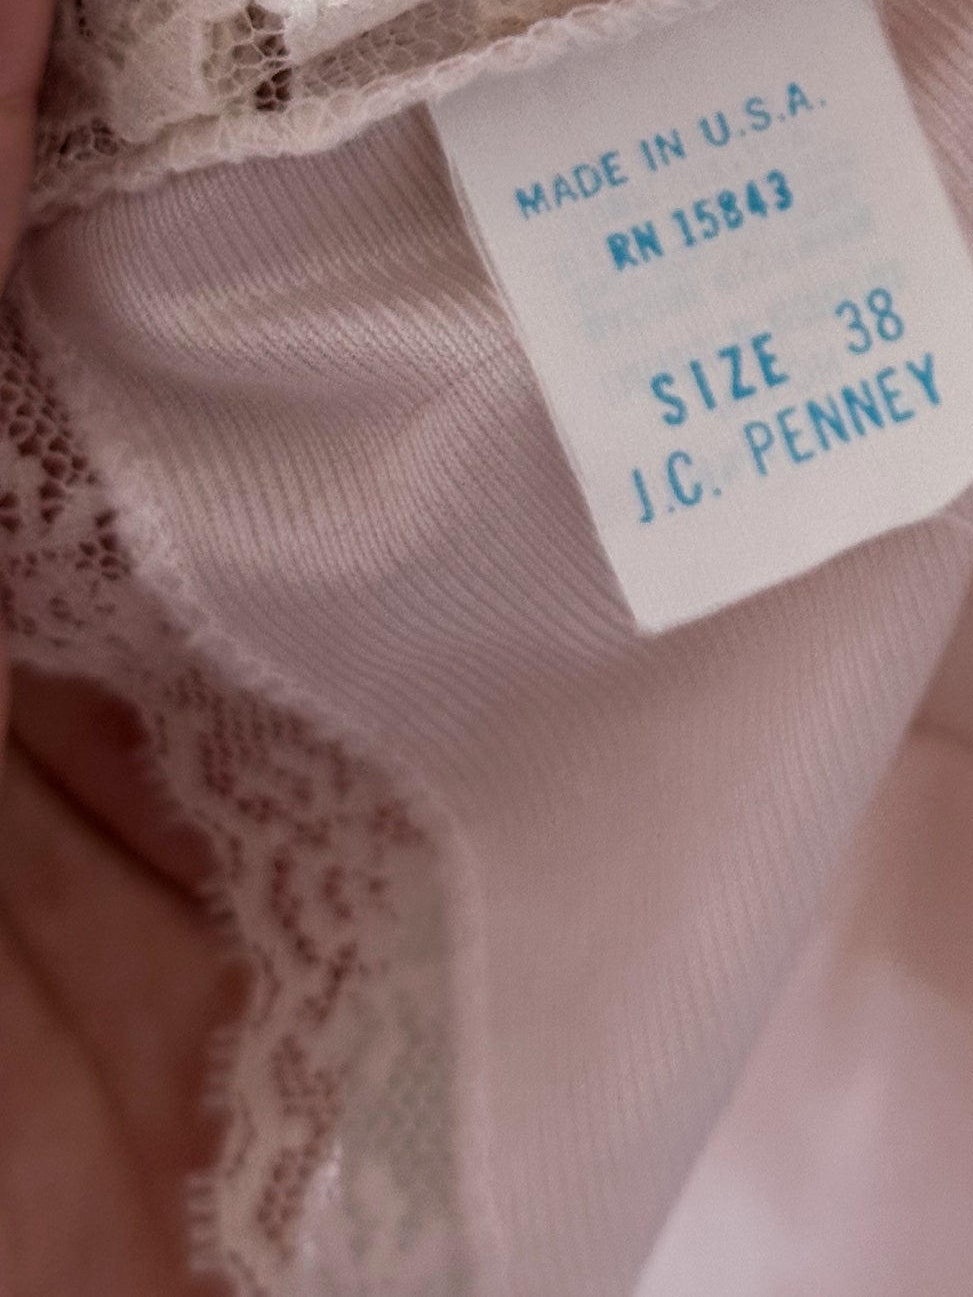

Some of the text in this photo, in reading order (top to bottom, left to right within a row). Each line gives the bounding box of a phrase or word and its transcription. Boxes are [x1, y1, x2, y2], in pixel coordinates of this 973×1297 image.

[514, 82, 827, 219] MADE IN U.S.A.
[606, 169, 794, 271] RN 15843
[649, 287, 905, 427] SIZE 38
[632, 353, 941, 524] J.C. PENNEY
